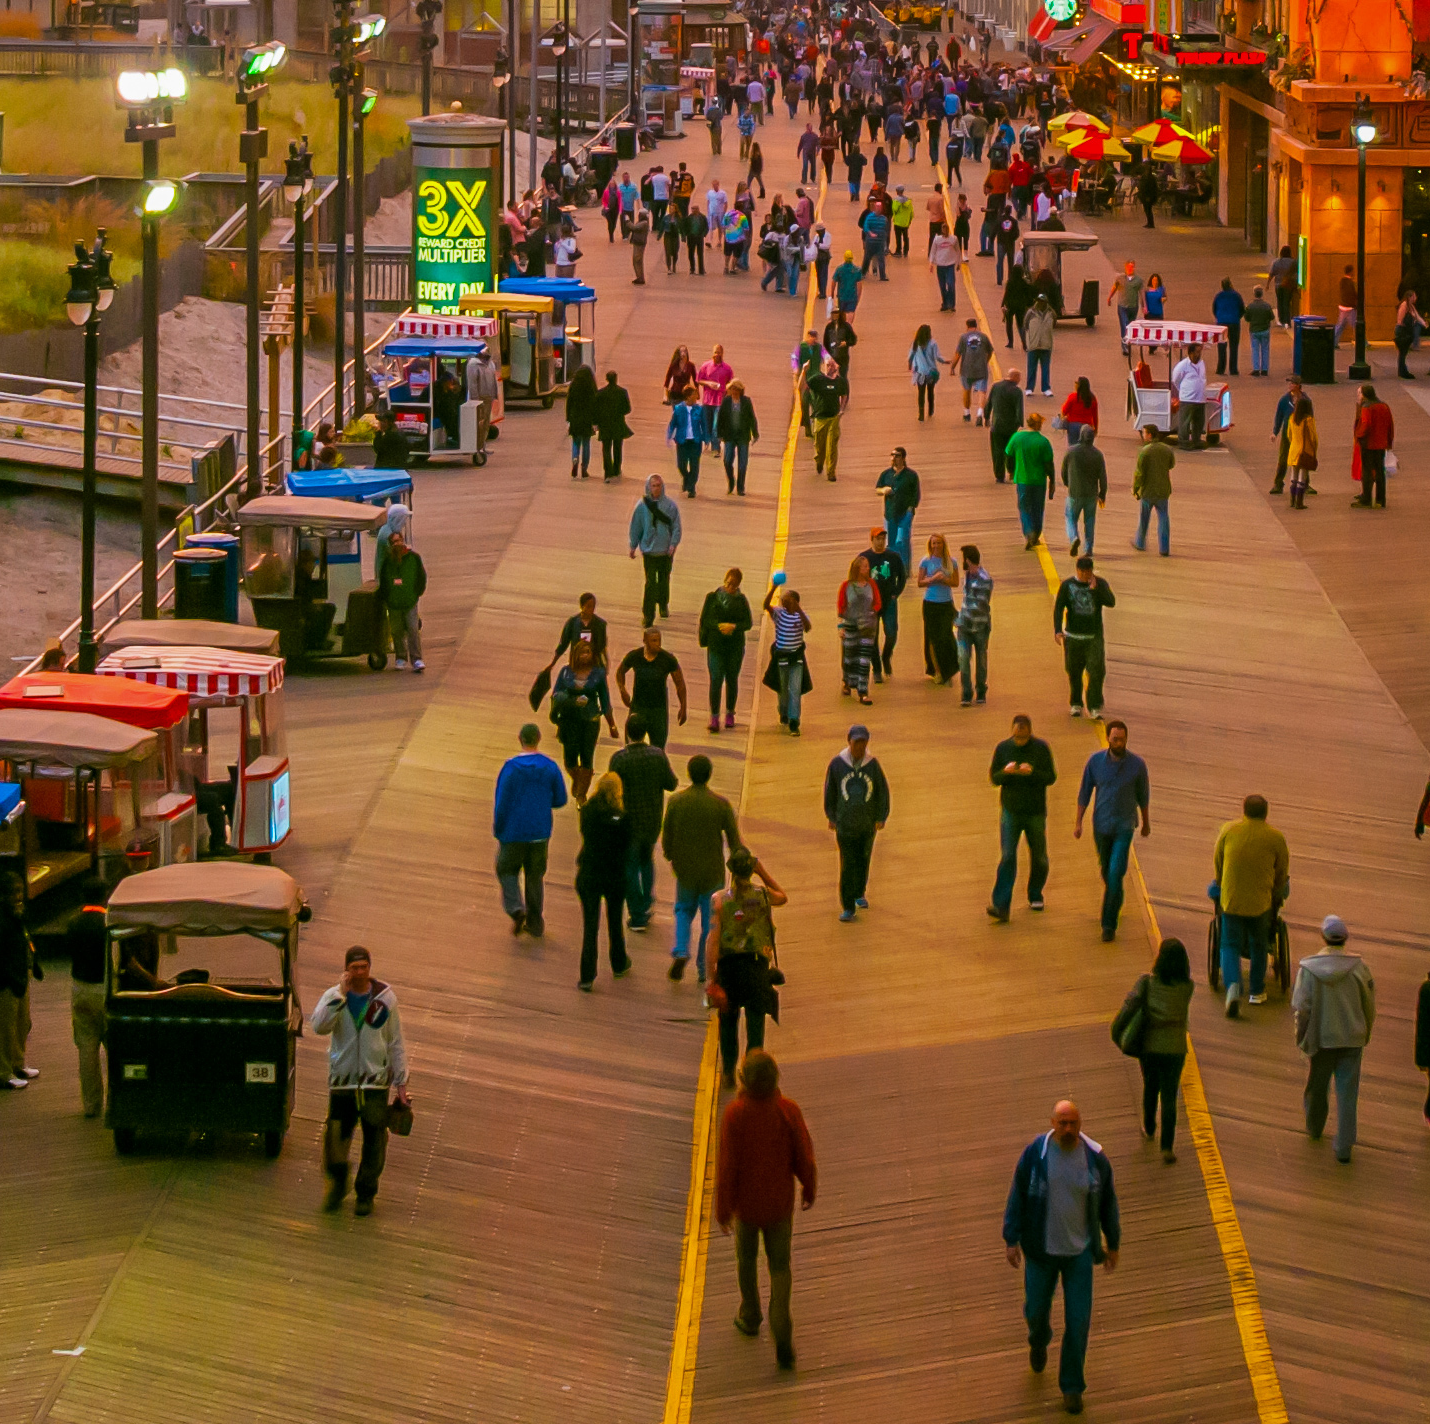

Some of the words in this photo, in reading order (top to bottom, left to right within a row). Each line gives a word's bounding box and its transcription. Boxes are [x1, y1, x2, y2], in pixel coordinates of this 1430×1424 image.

[417, 180, 487, 237] 3X
[418, 237, 454, 249] REWARD
[455, 238, 486, 249] CREDIT
[417, 248, 486, 264] MULTIPLIER
[417, 281, 456, 301] EVERY
[459, 282, 485, 295] DAY
[252, 1068, 269, 1078] 38
